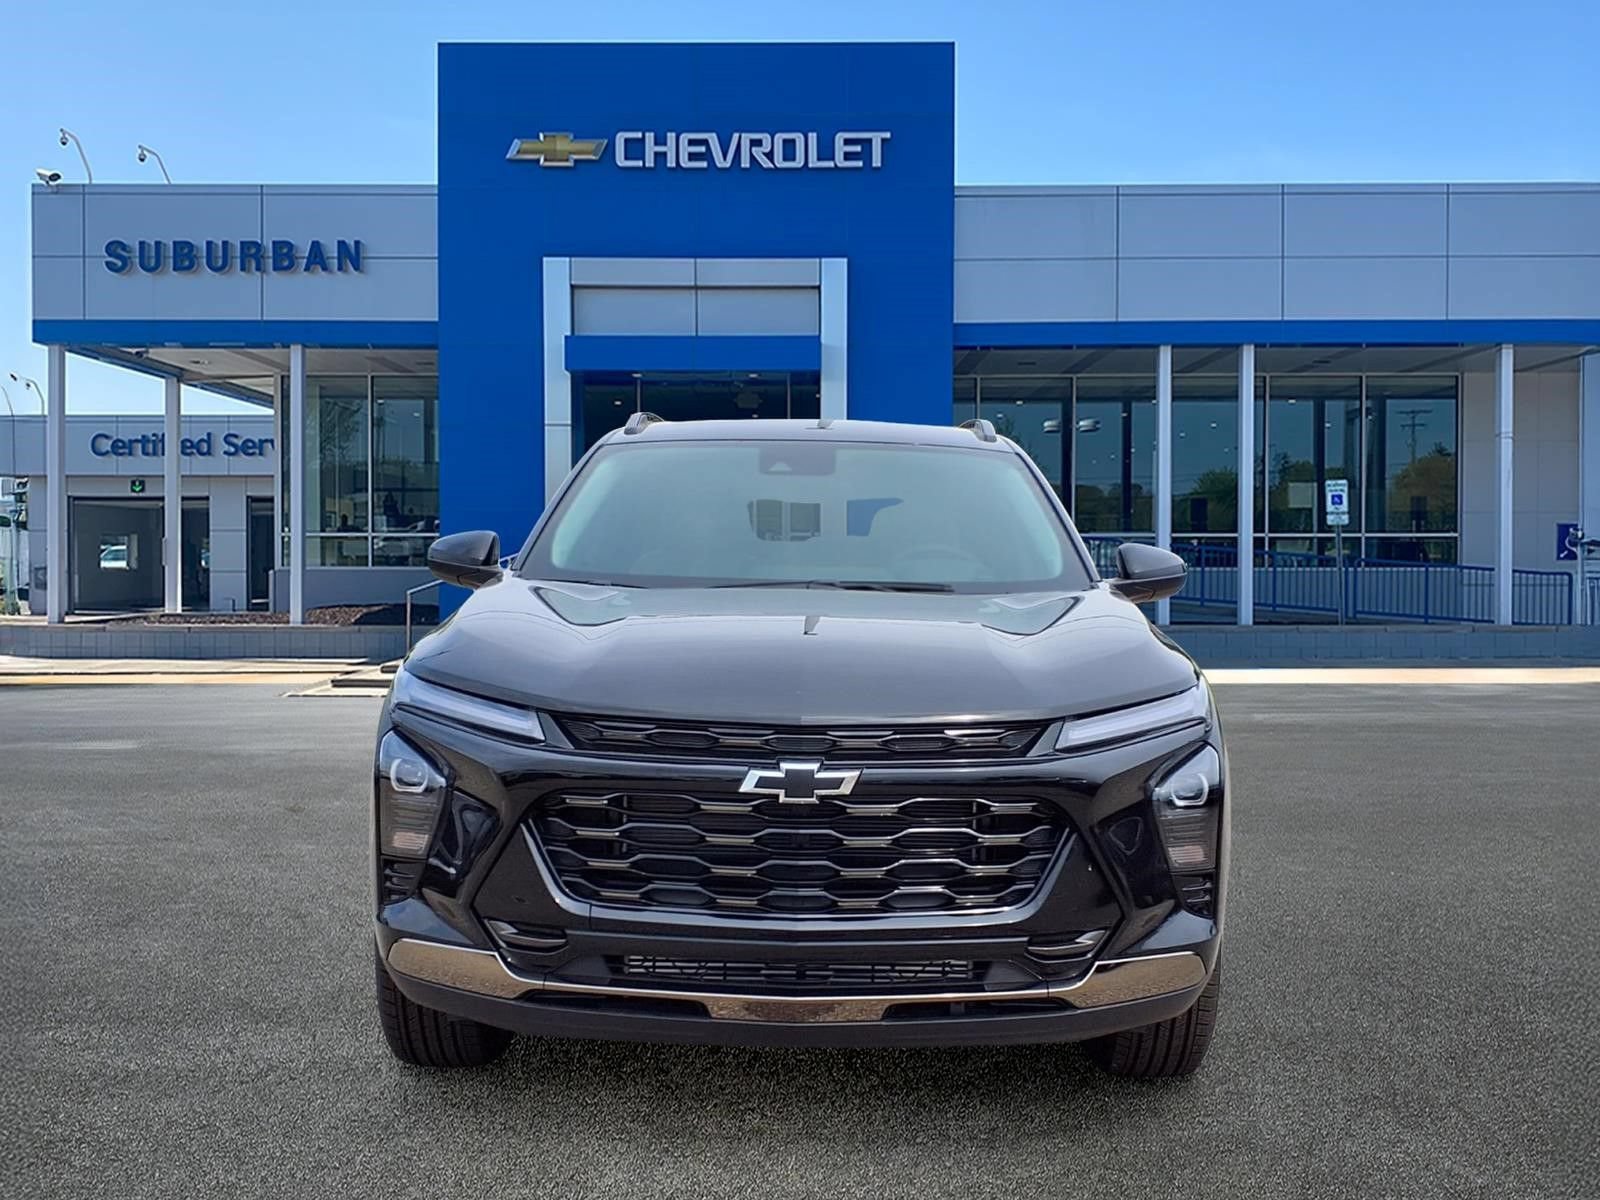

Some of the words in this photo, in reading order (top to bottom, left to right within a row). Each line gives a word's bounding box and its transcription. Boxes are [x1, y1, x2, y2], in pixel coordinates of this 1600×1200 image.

[614, 131, 891, 169] CHEVROLET
[104, 239, 362, 273] SUBURBAN
[91, 432, 213, 457] Certifed
